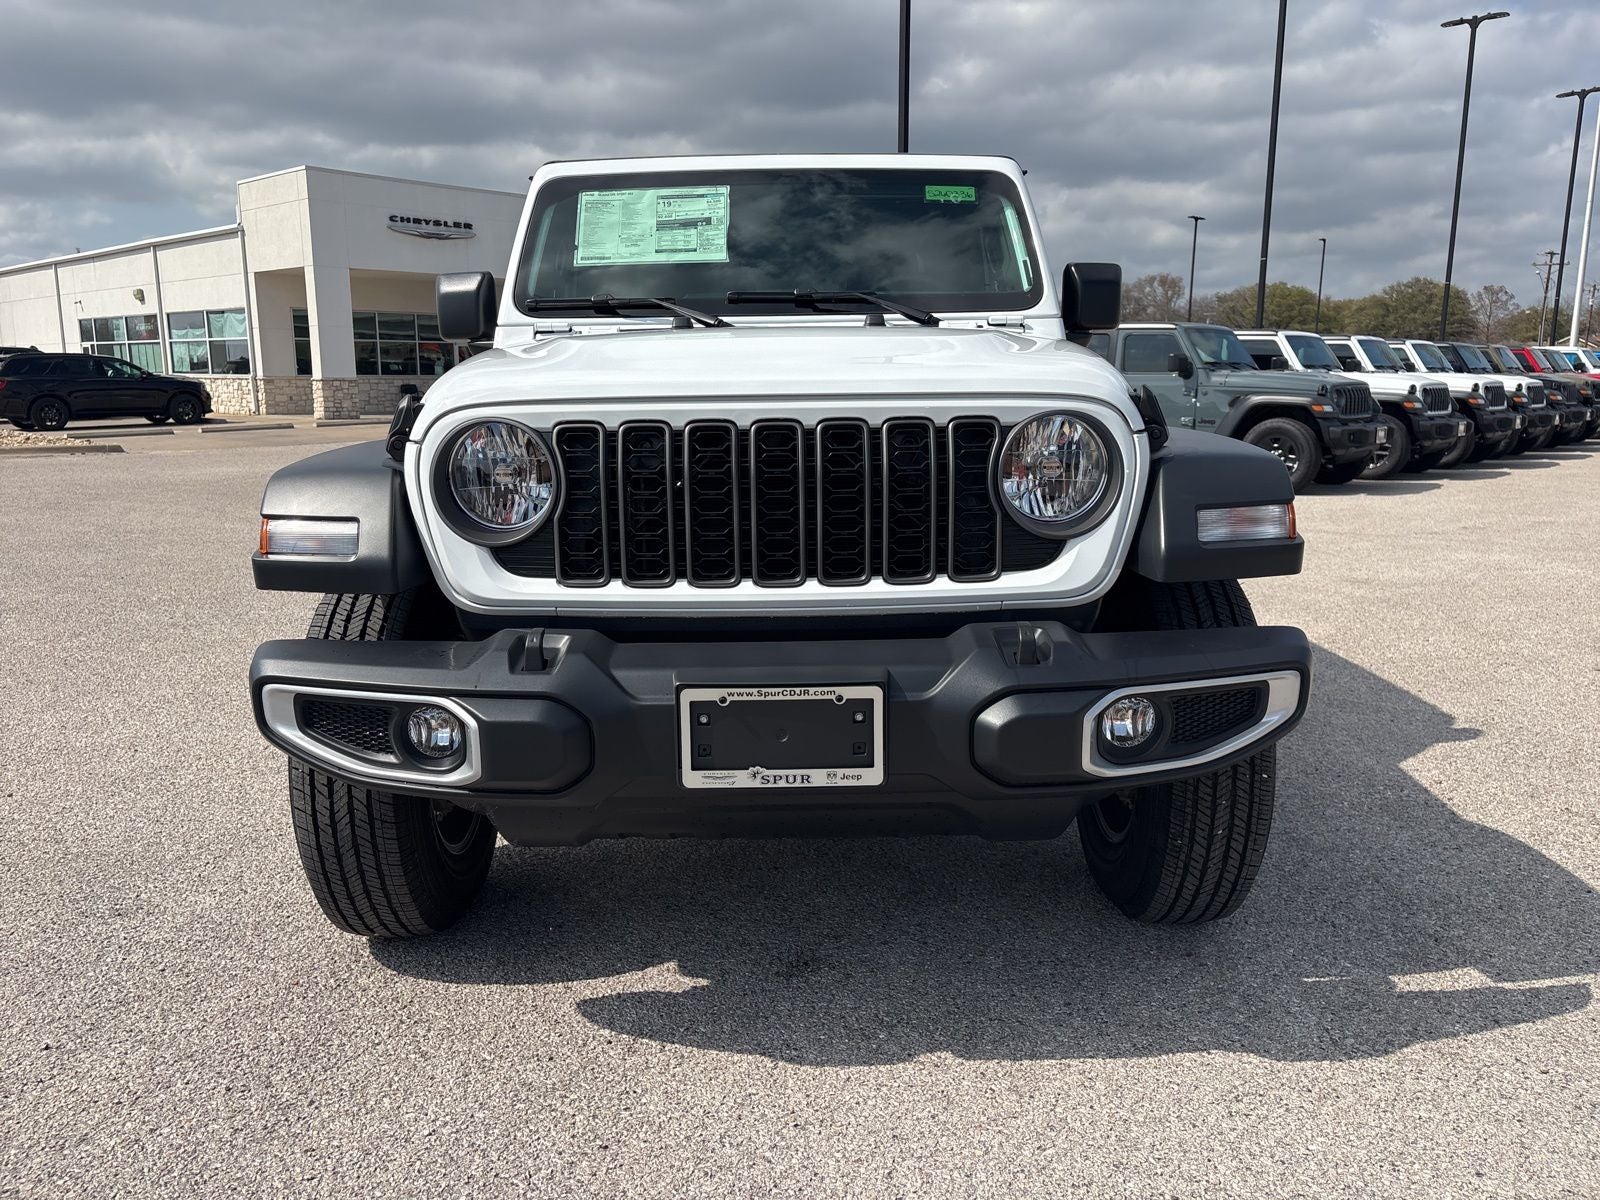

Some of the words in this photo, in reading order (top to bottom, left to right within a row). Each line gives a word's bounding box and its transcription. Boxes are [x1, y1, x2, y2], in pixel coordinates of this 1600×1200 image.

[388, 215, 474, 230] CHRYSLER
[726, 689, 836, 699] www.SpurCDJR.com
[760, 774, 812, 785] SPUR
[840, 773, 863, 782] Jeep
